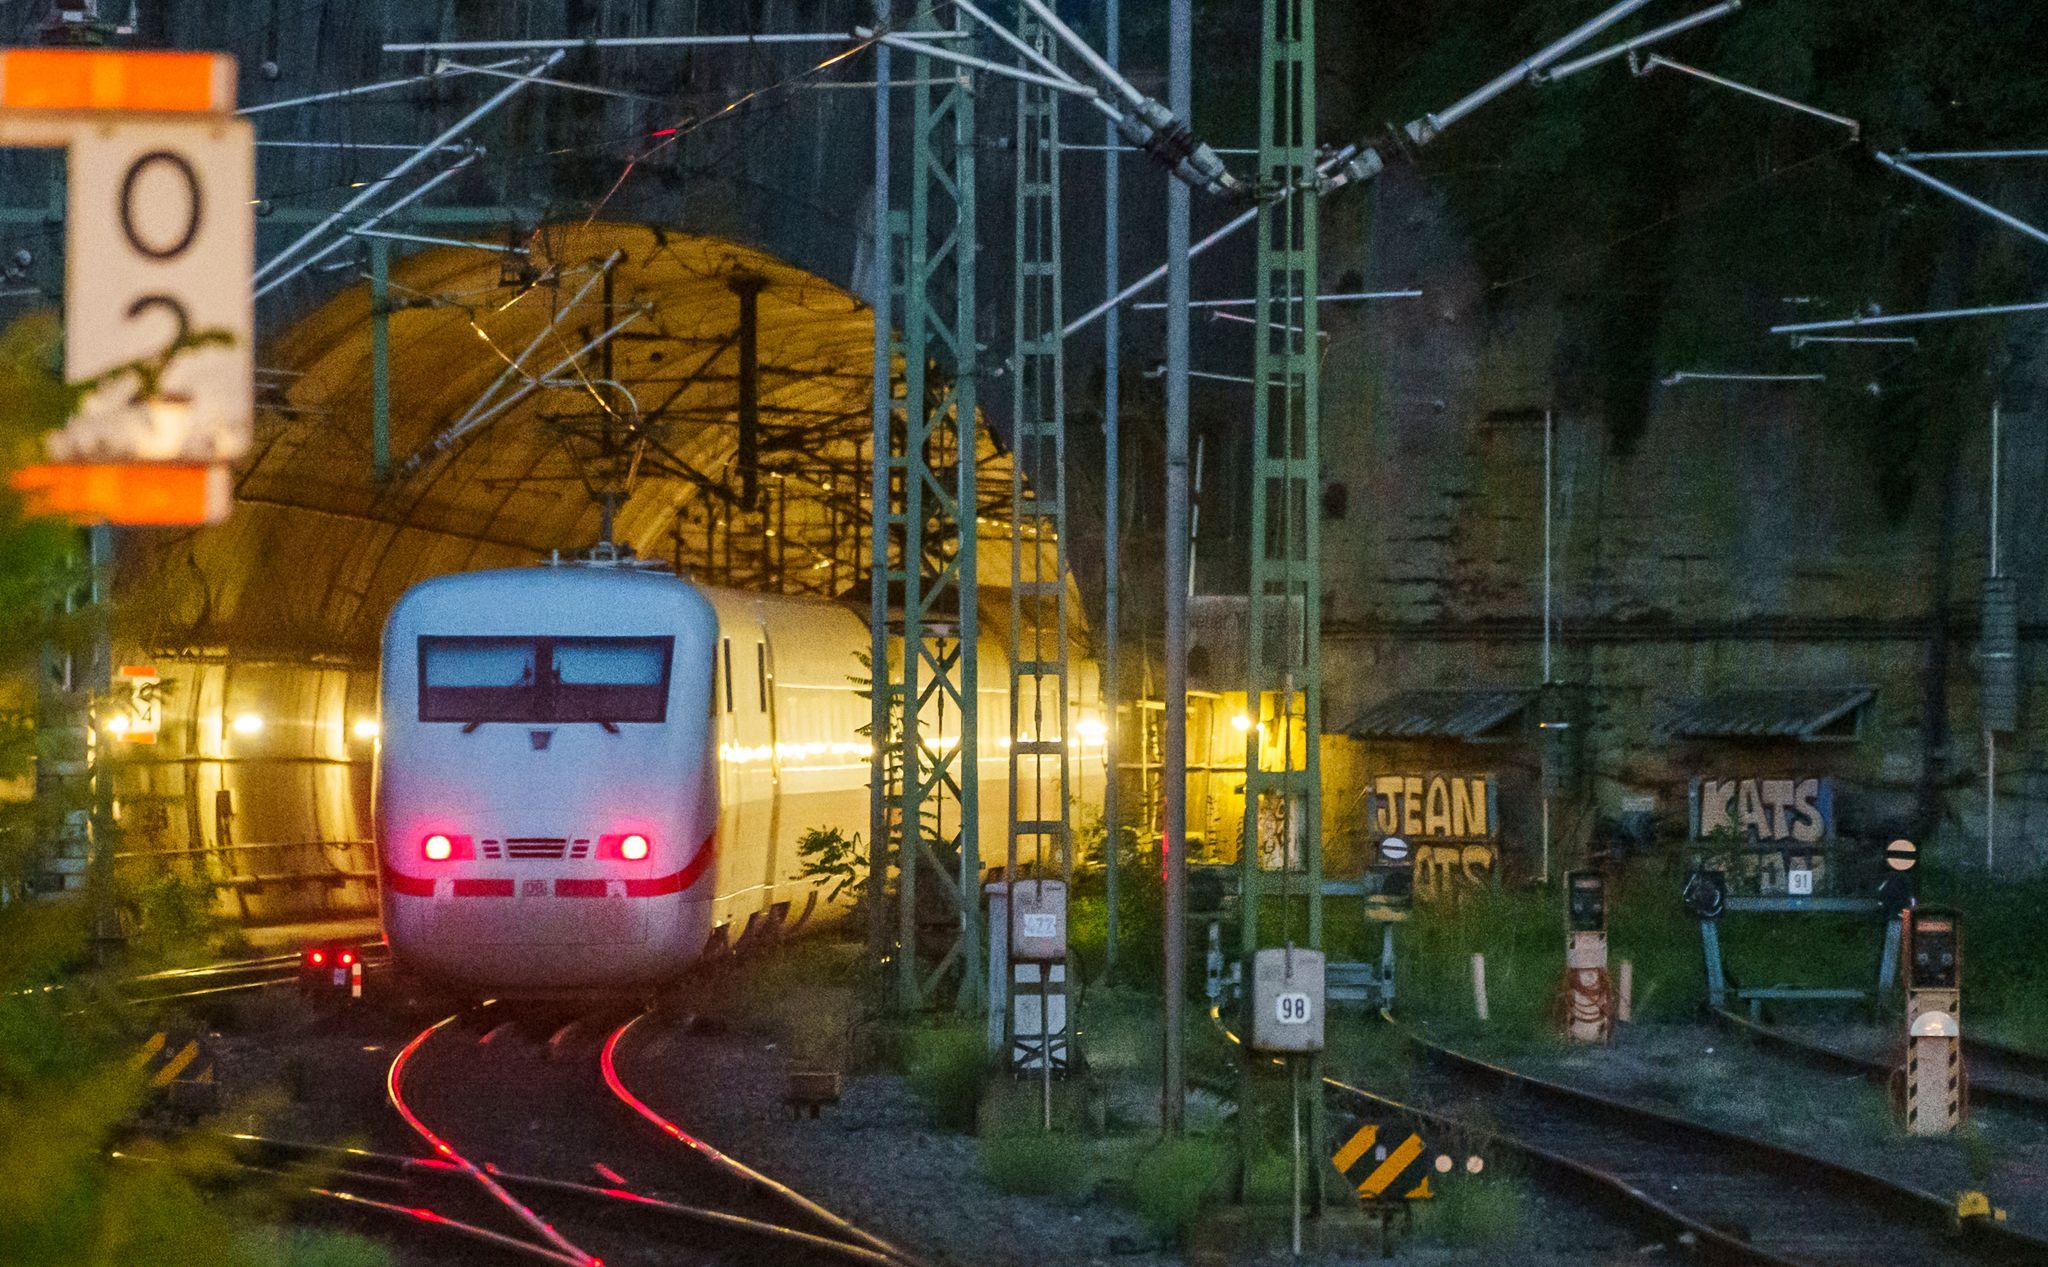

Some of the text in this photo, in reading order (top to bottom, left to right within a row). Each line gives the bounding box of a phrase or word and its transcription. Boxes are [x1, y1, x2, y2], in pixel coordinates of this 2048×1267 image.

[118, 149, 204, 261] 0
[123, 294, 193, 405] 2
[1375, 775, 1487, 837] JEAN
[1701, 777, 1826, 843] KATS
[1795, 874, 1807, 889] 91
[1283, 998, 1304, 1019] 98
